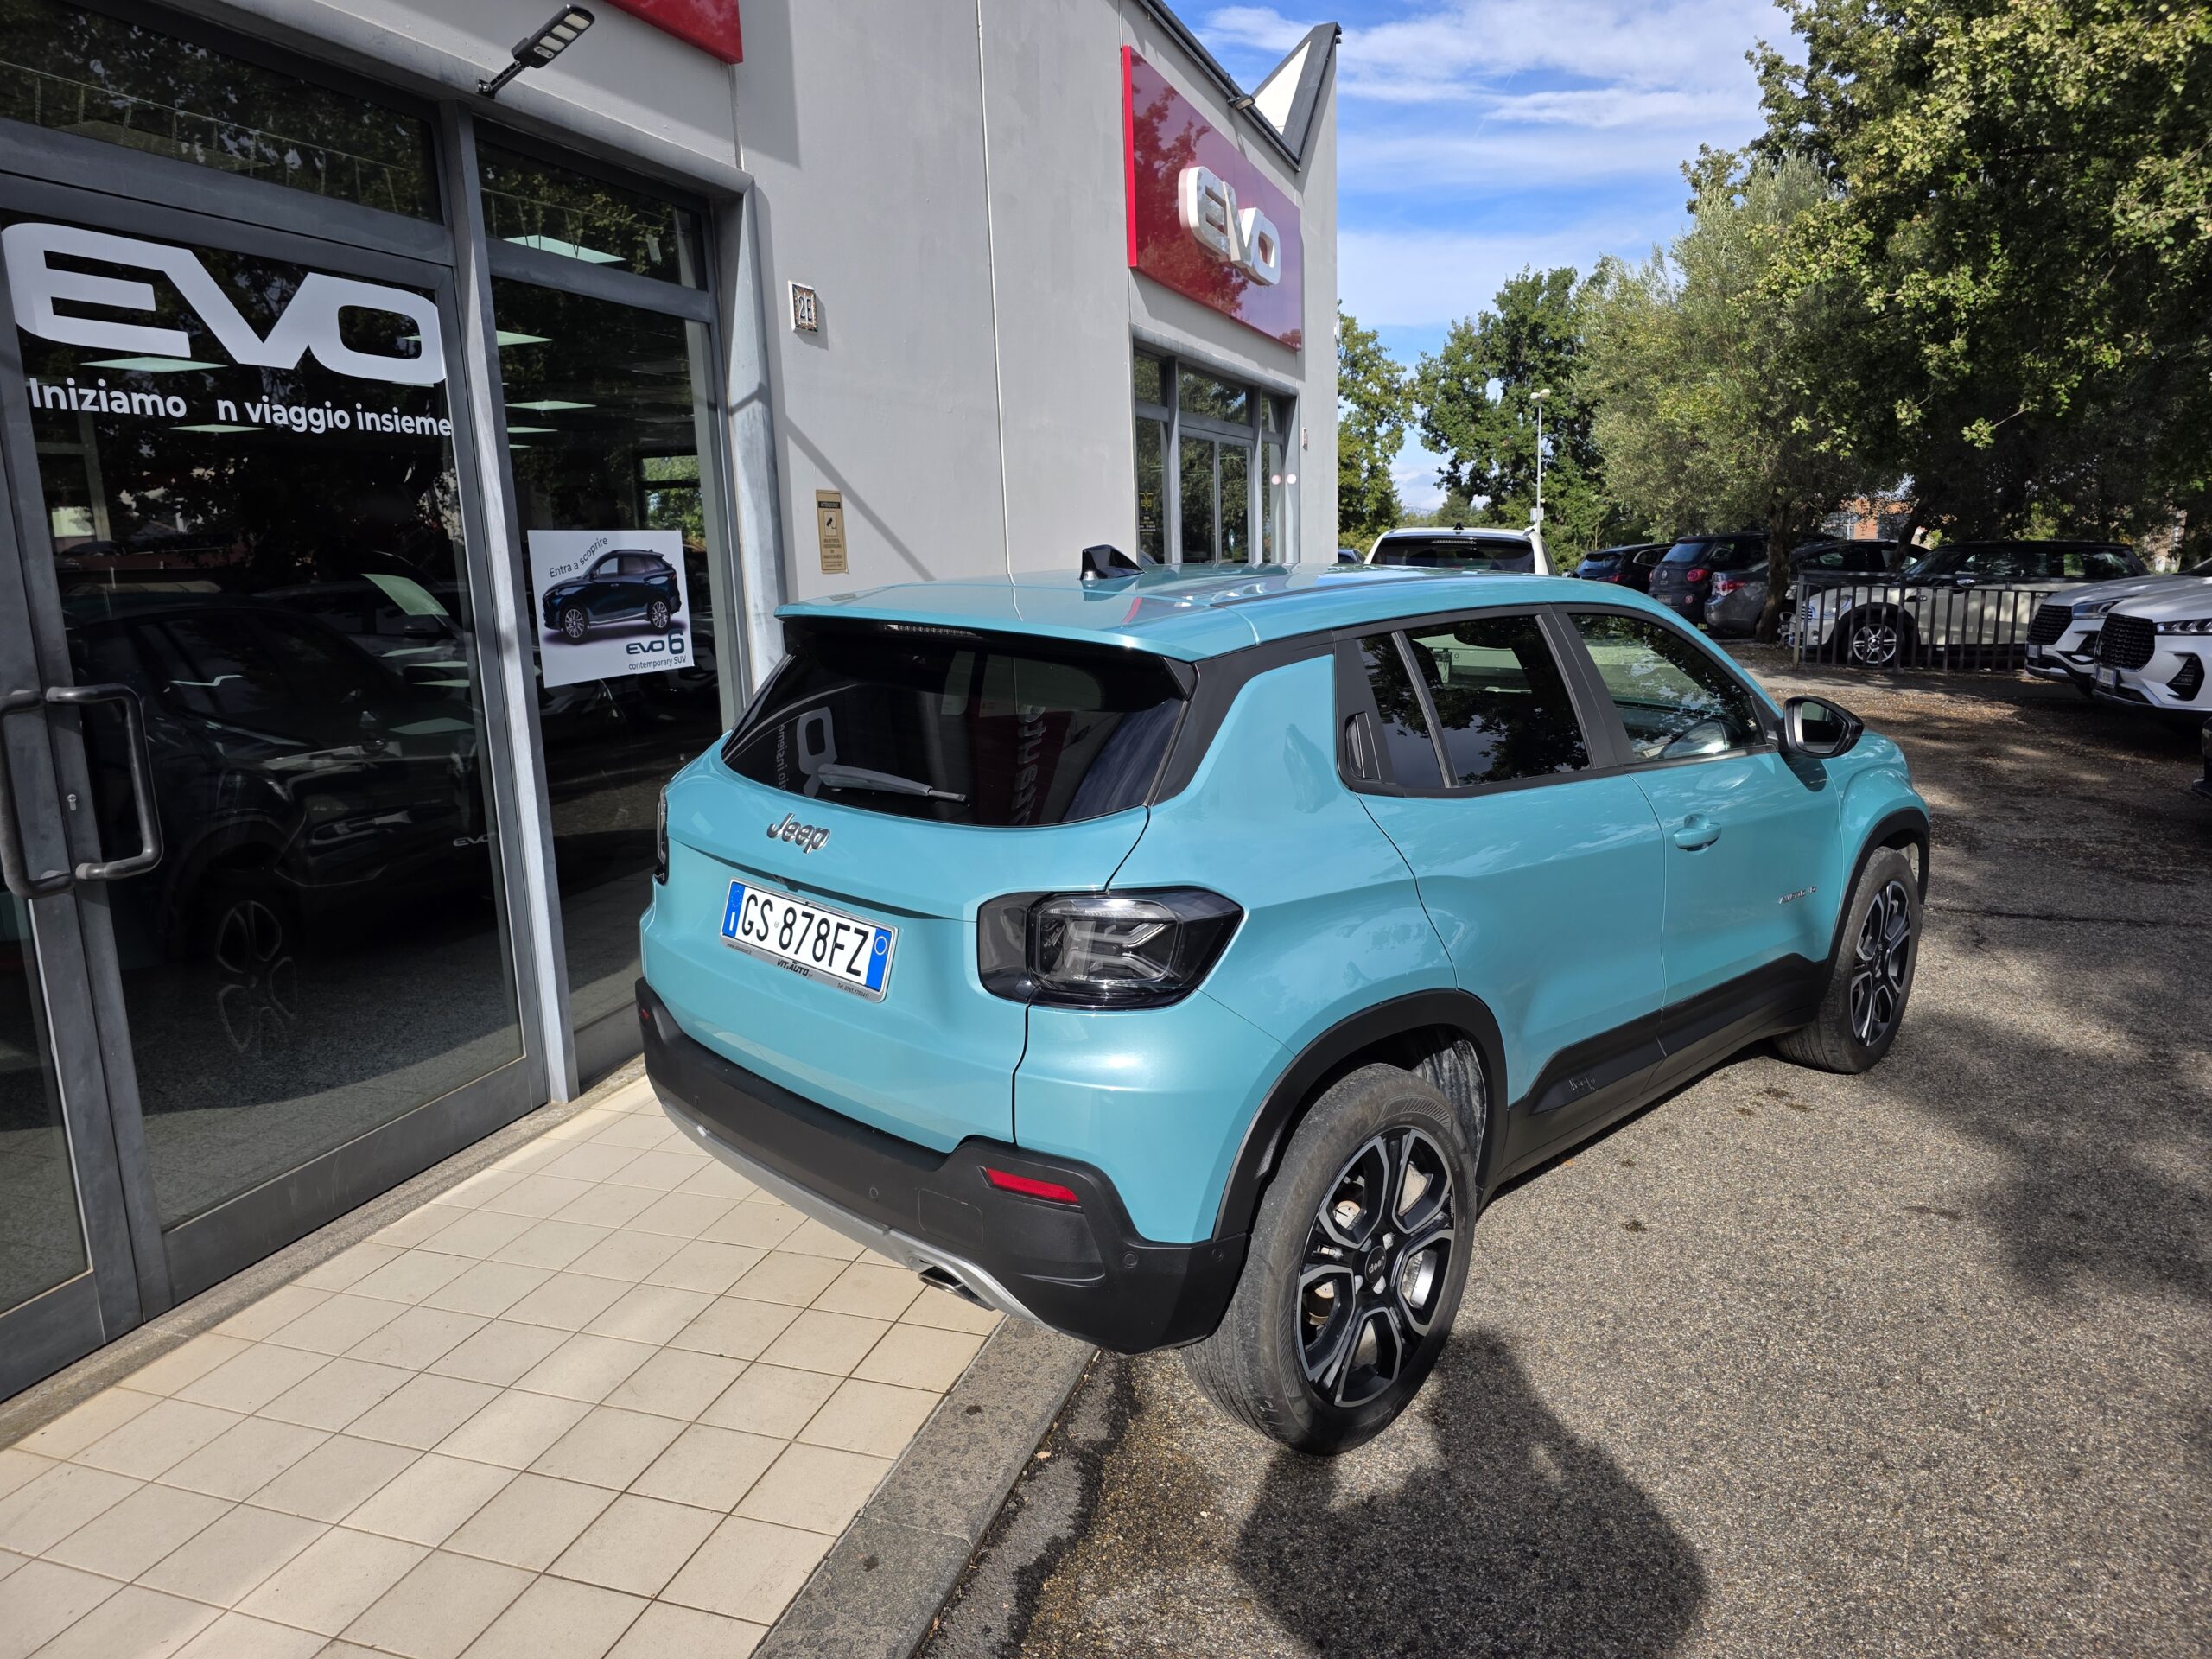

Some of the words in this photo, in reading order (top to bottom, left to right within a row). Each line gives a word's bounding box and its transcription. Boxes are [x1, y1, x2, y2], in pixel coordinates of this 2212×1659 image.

[1179, 167, 1281, 285] EVO
[1, 222, 447, 385] EVO
[29, 378, 188, 419] Iniziamo
[244, 395, 350, 434] viaggio
[356, 405, 453, 437] insieme
[549, 563, 573, 578] Entra
[574, 562, 579, 571] a
[581, 537, 608, 566] scoprire
[626, 639, 665, 655] EVO
[667, 628, 685, 655] 6
[628, 657, 673, 671] contemporary
[673, 654, 687, 664] SUV
[766, 813, 831, 855] Jeep
[741, 893, 773, 942] GS
[779, 906, 869, 977] 878FZ
[1369, 1255, 1384, 1274] Jeep
